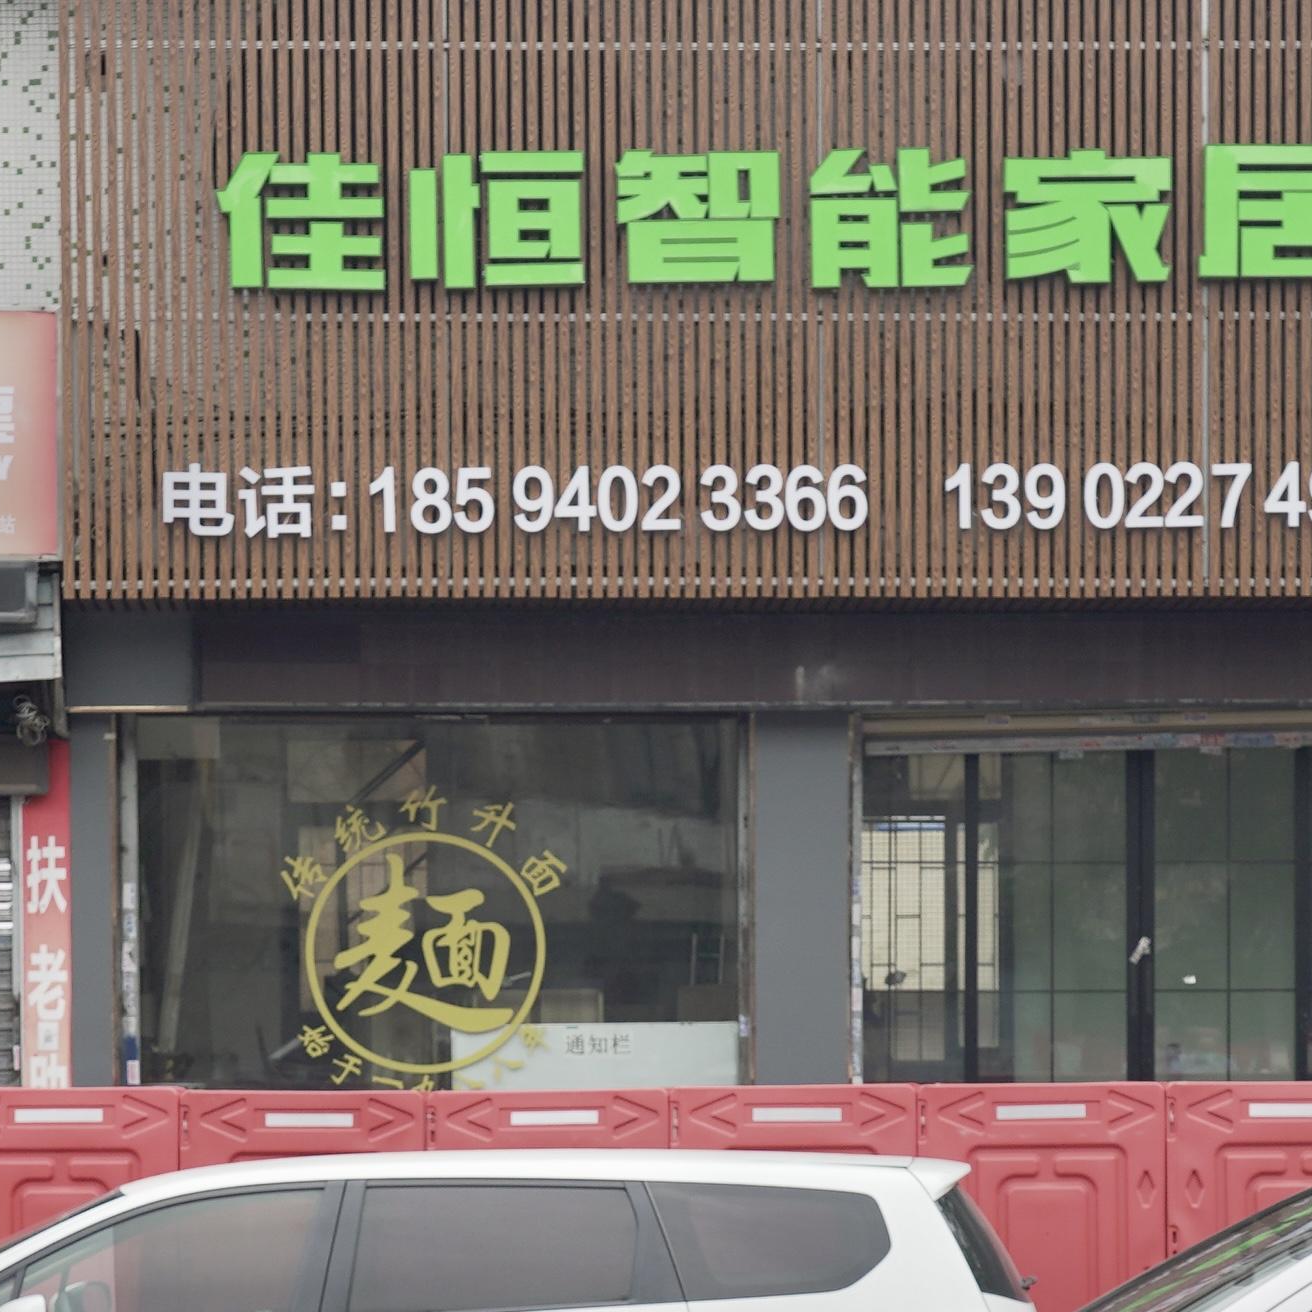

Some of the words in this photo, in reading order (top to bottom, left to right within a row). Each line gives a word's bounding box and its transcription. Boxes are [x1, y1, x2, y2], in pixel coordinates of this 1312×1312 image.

[369, 466, 495, 533] 185
[513, 465, 681, 532] 9402
[700, 464, 868, 532] 3366
[945, 463, 1066, 530] 139
[1084, 462, 1252, 529] 0227
[566, 1033, 632, 1055] 通知栏
